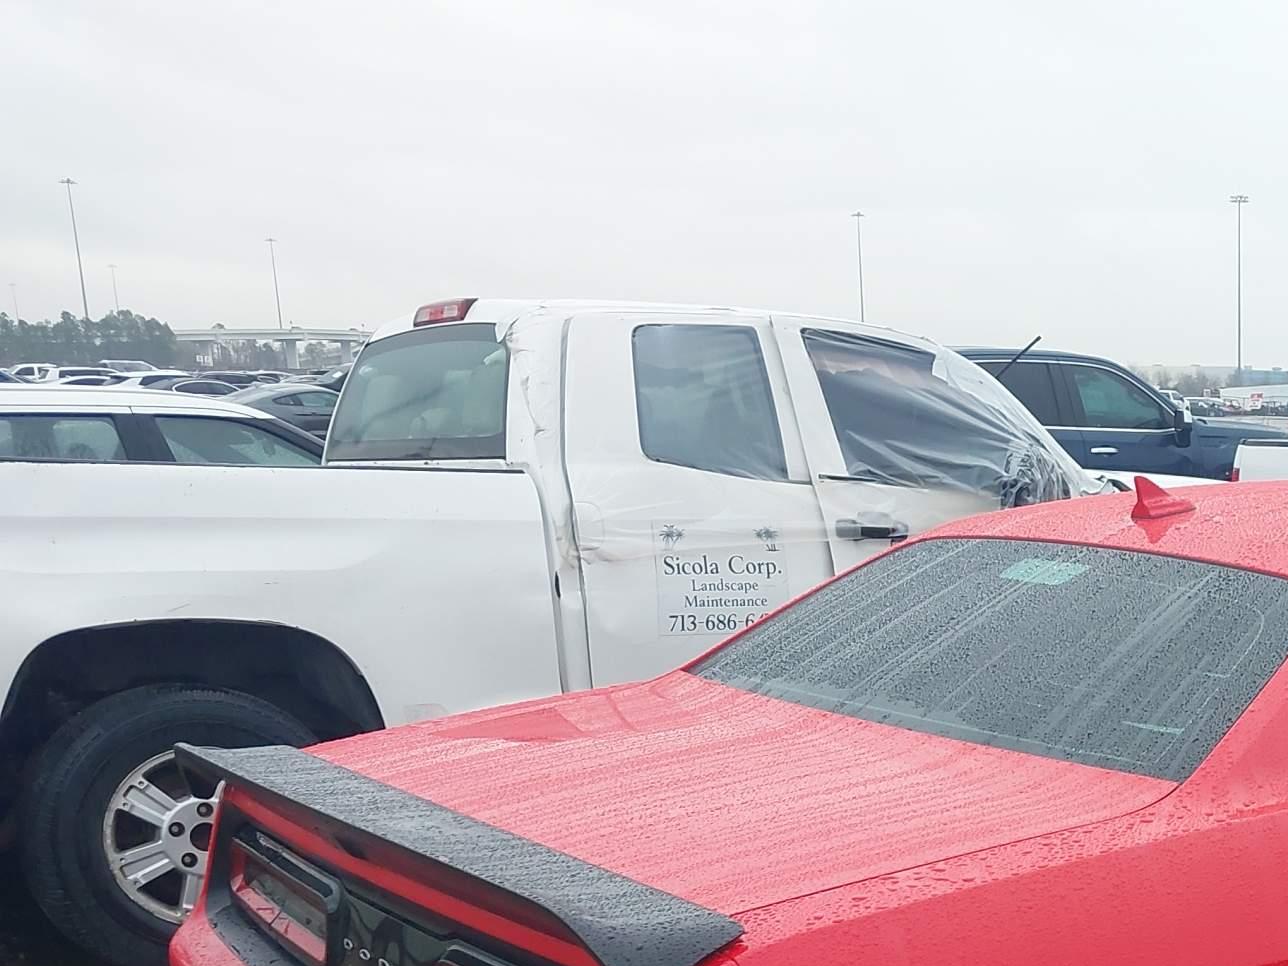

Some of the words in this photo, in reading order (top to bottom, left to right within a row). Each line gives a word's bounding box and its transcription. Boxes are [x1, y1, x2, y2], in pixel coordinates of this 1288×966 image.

[663, 555, 719, 575] Sicola
[728, 556, 782, 579] Corp.
[691, 578, 759, 594] Landscape
[684, 595, 768, 608] Maintenance
[668, 613, 768, 632] 713-686-6
